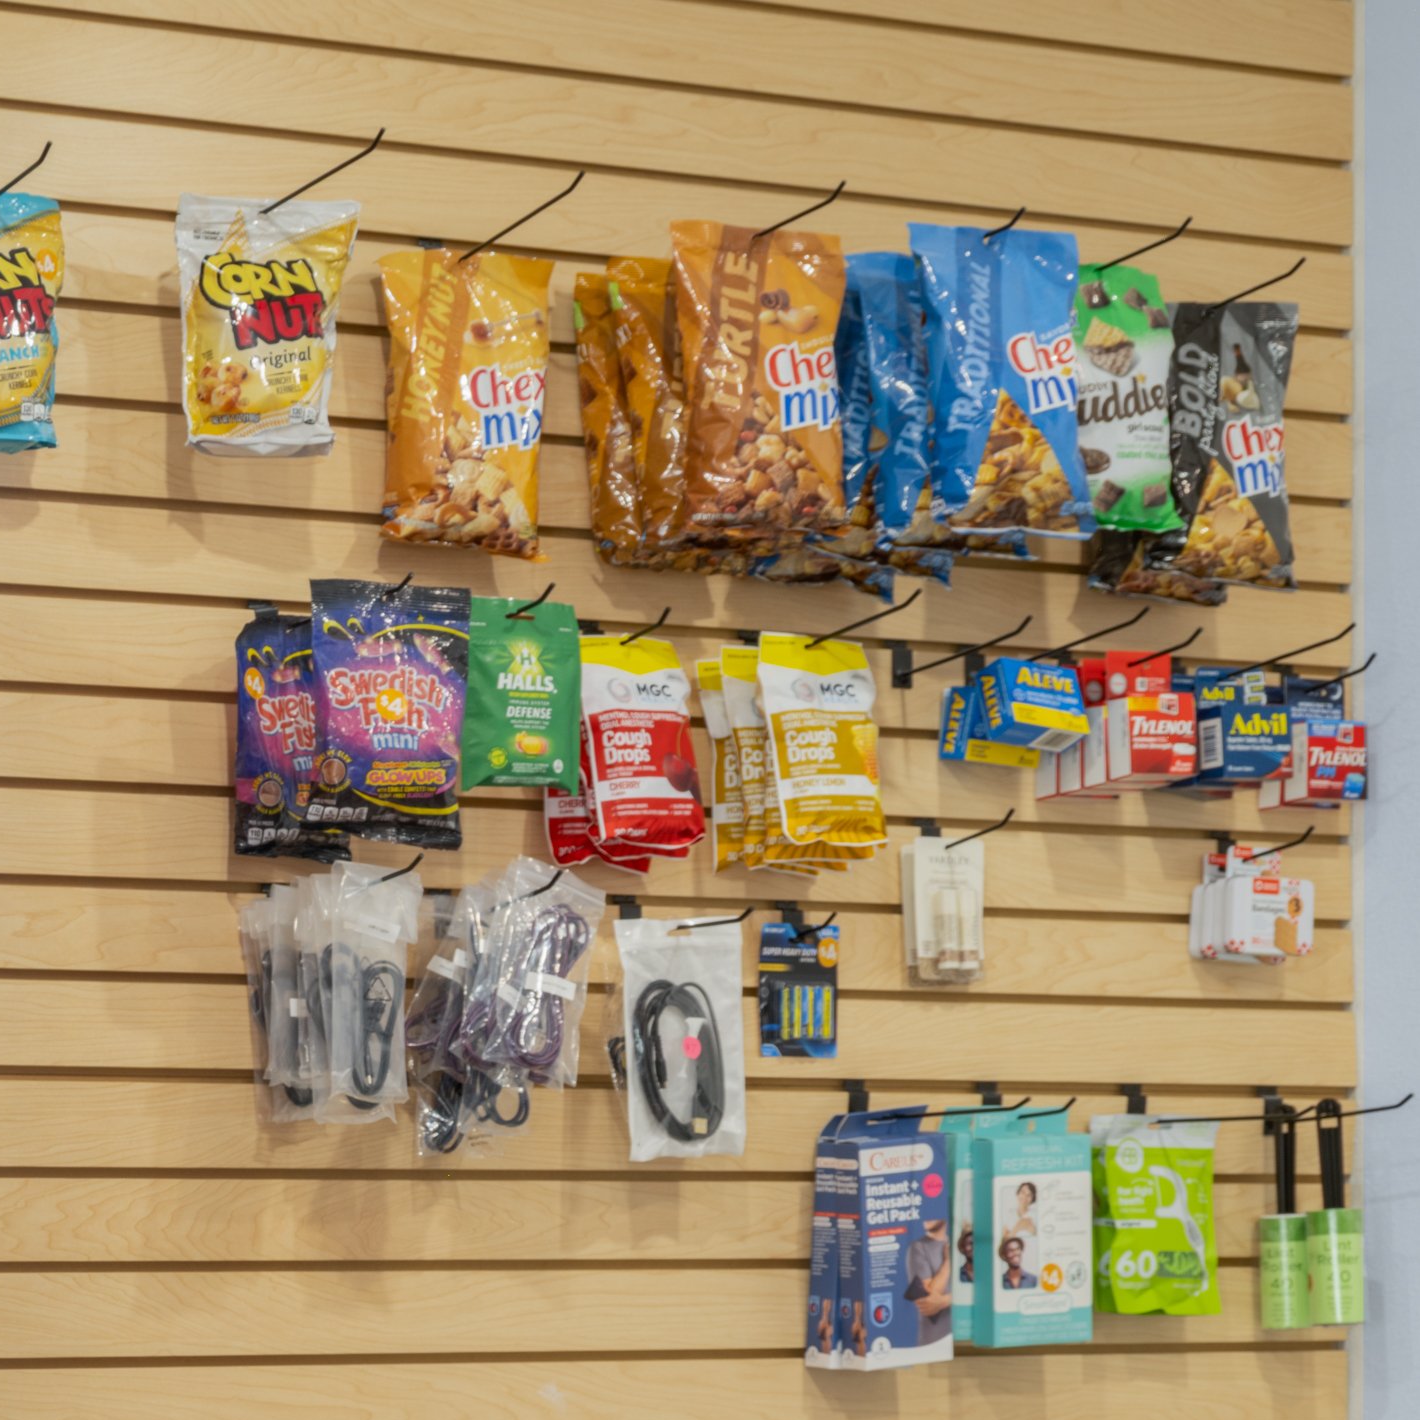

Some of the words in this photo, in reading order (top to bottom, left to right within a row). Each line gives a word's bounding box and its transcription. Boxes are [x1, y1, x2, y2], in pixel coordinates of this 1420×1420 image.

[199, 252, 318, 310] CORN
[705, 250, 760, 409] TURTLE
[946, 259, 992, 435] TRADITIONAL
[1172, 342, 1209, 437] BOLD
[328, 668, 445, 708] Swedish
[497, 672, 554, 691] HALLS
[636, 683, 672, 696] MGC
[1016, 668, 1075, 694] ALEVE
[506, 706, 552, 720] DEFENSE
[1130, 715, 1194, 736] TYLENOL
[1229, 711, 1288, 736] Advil
[372, 734, 419, 751] mini
[602, 730, 652, 750] Cough
[604, 748, 651, 764] Drops
[865, 1182, 908, 1197] Instant
[865, 1194, 923, 1209] Reusable
[866, 1209, 888, 1224] Gel
[889, 1207, 920, 1223] Pack
[1115, 1250, 1157, 1280] 60
